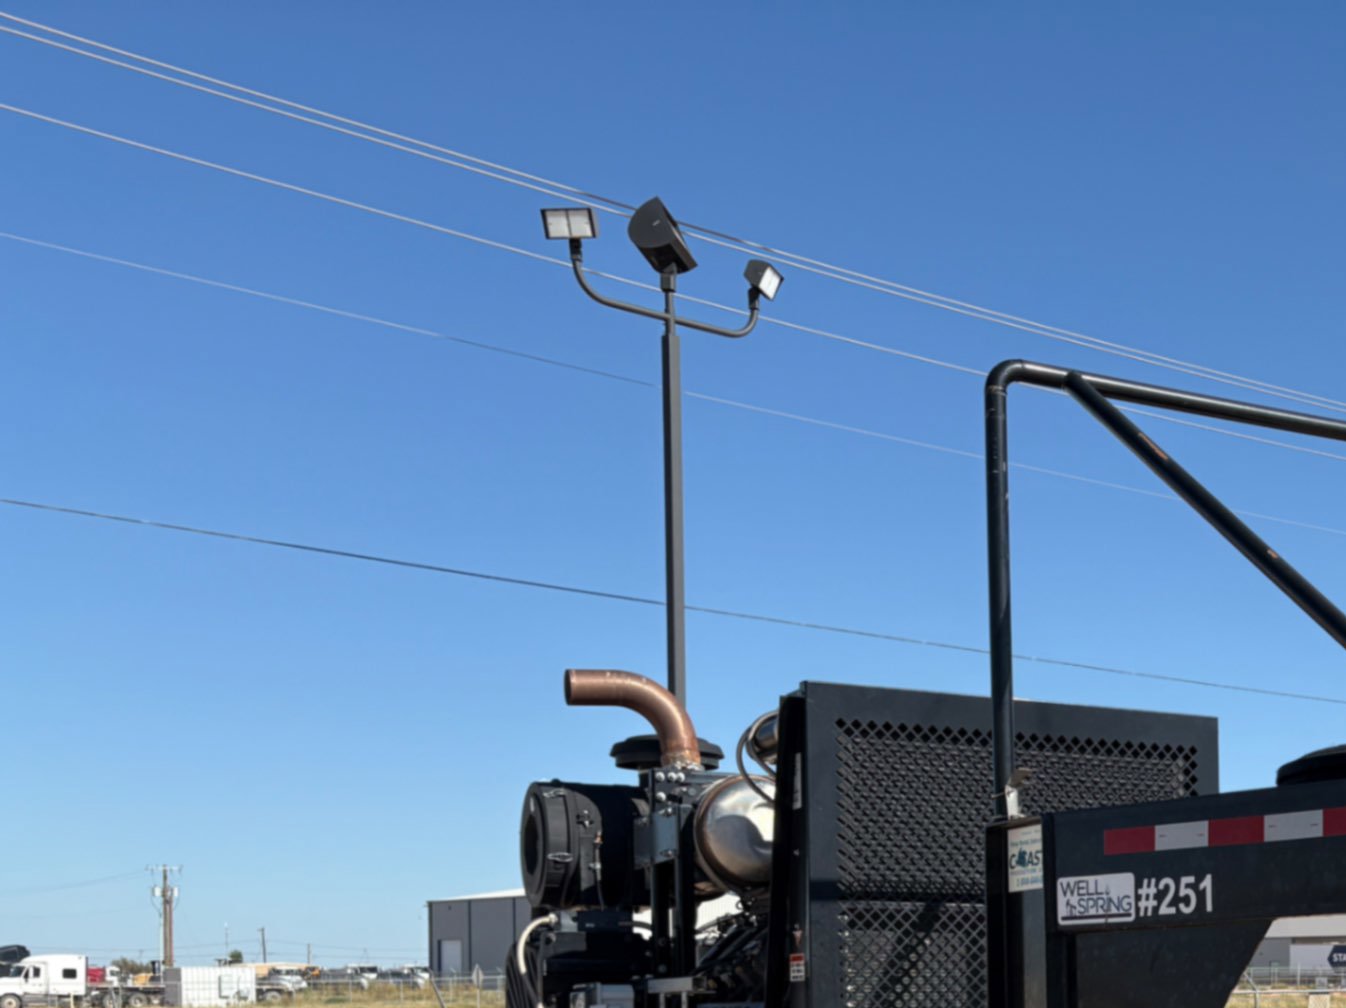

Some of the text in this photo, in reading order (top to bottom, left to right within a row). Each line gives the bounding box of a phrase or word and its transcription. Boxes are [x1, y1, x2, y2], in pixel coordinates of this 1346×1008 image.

[1009, 849, 1043, 869] CAS
[1060, 879, 1102, 897] WELL
[1137, 873, 1213, 917] #251
[1078, 894, 1133, 915] SPRING
